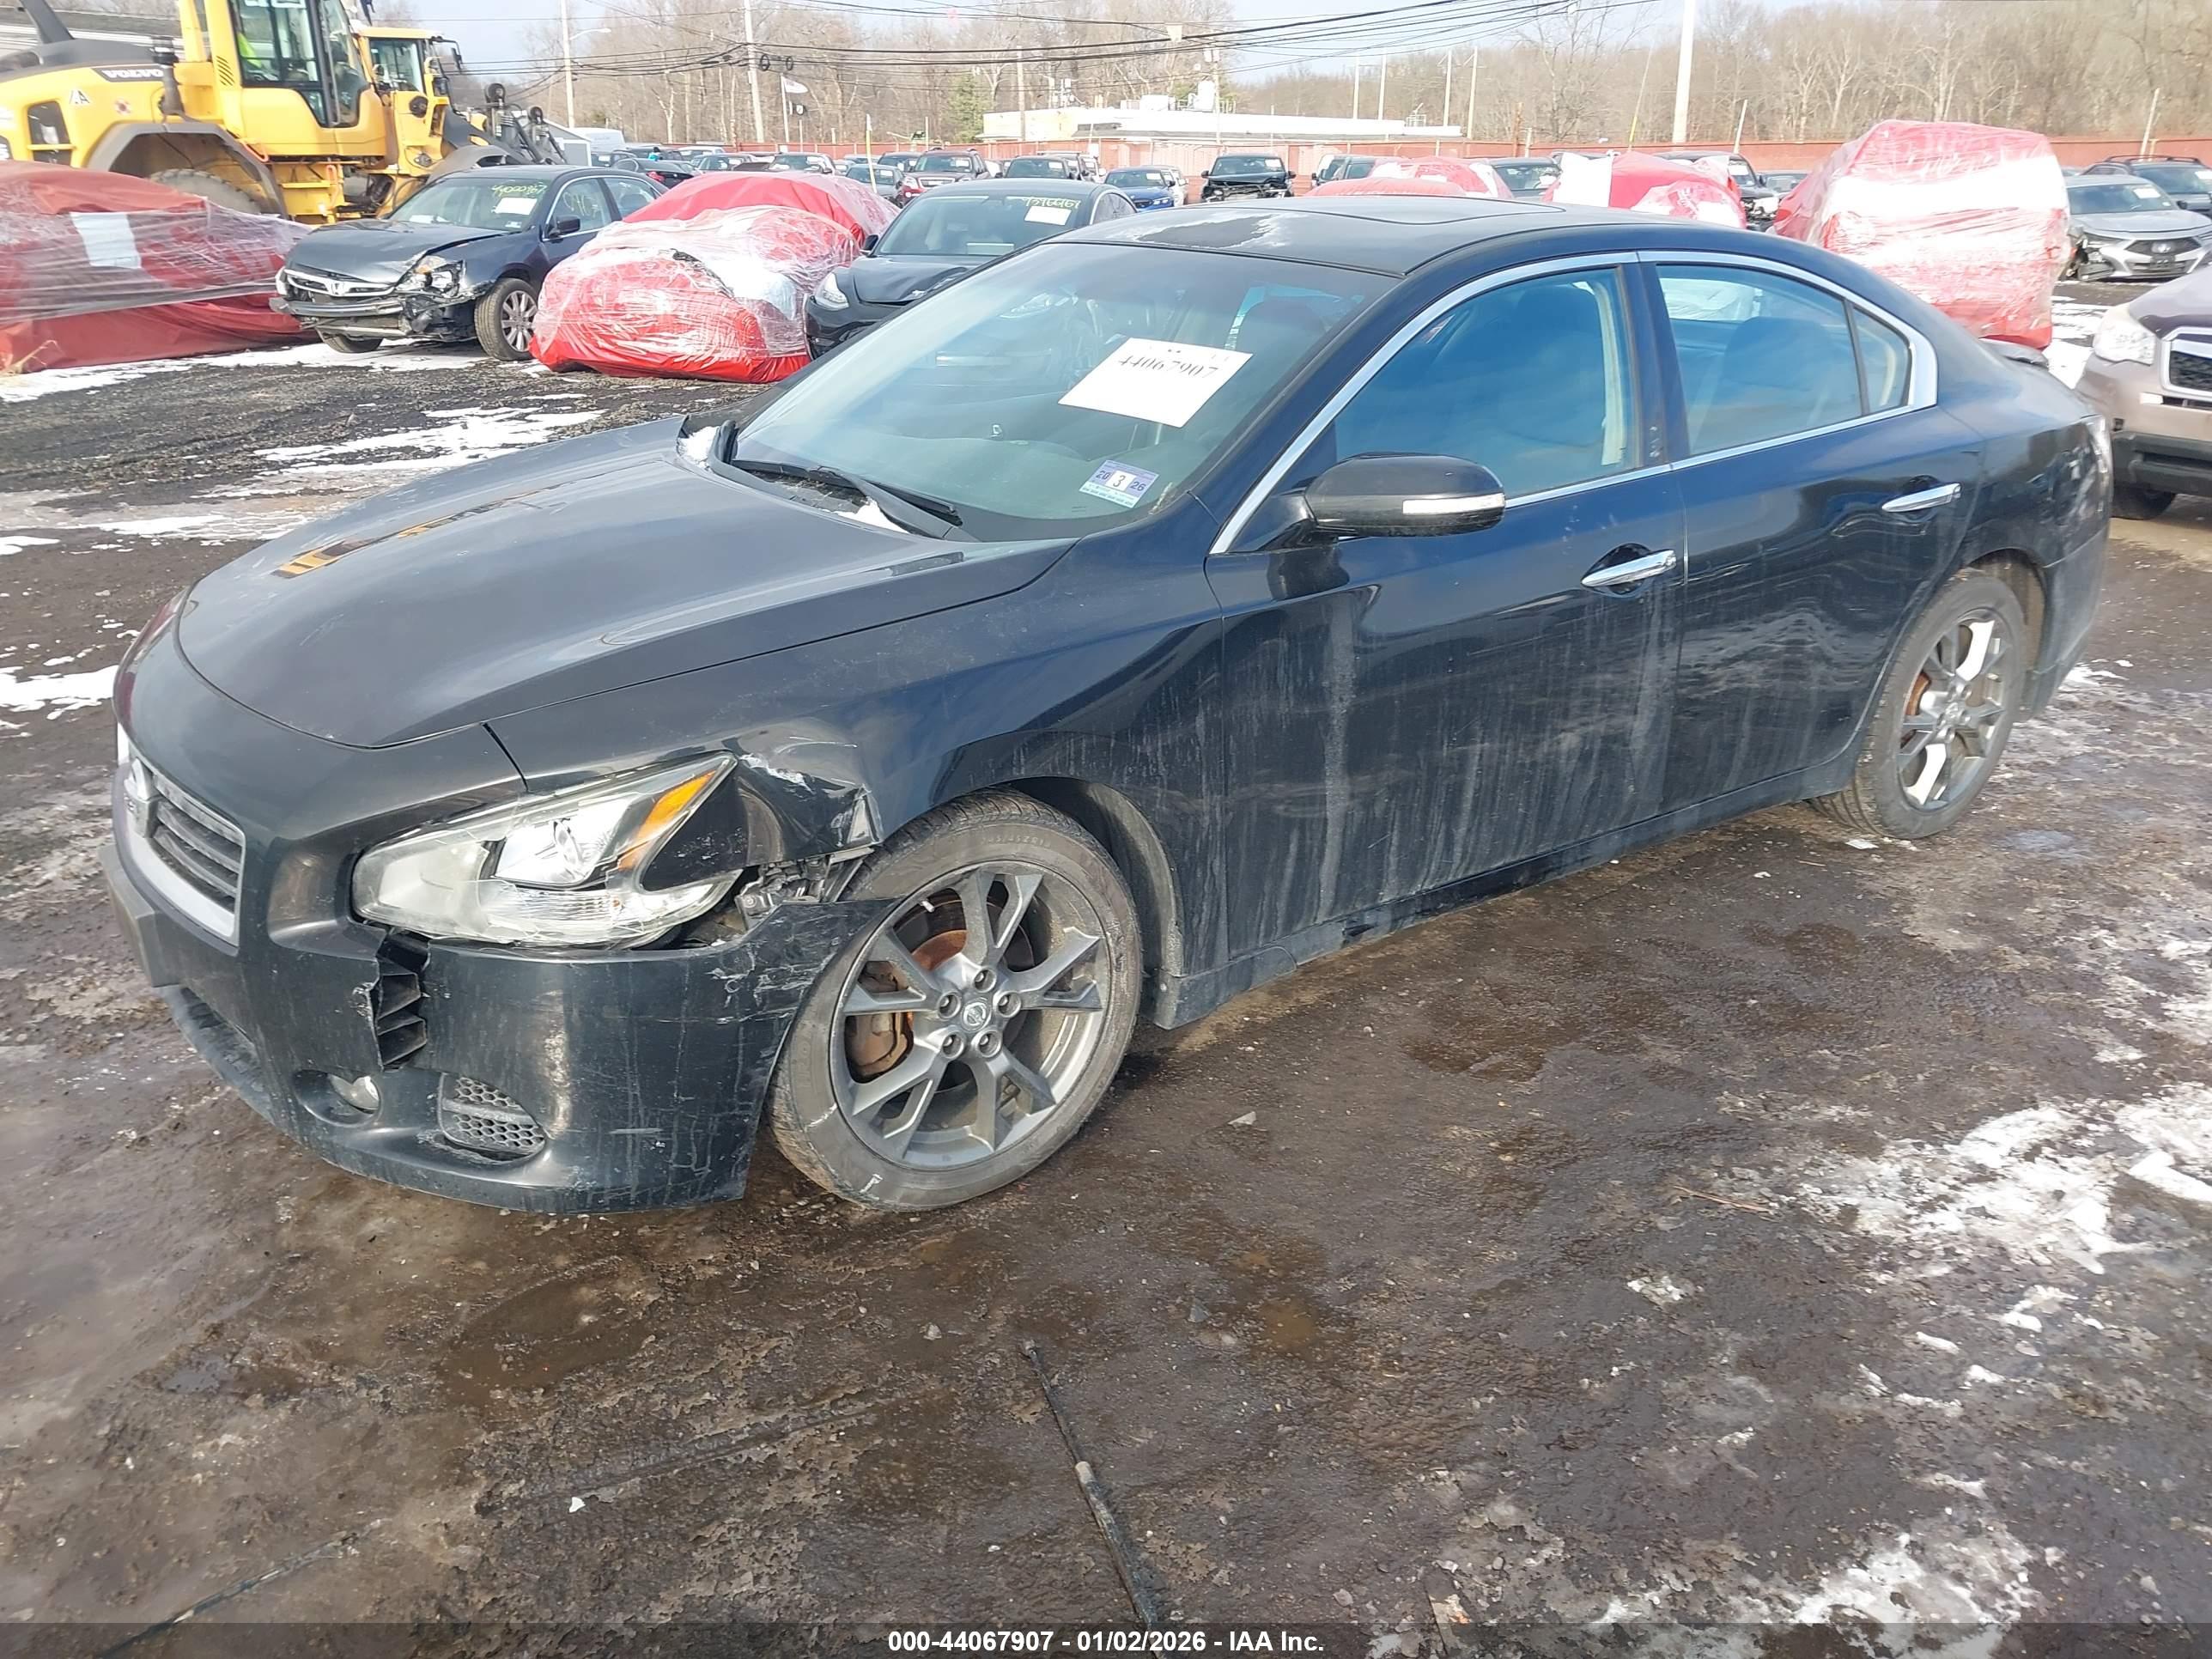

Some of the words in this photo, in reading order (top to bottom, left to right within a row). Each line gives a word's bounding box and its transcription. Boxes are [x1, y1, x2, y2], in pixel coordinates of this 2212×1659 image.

[101, 69, 165, 78] VOLVO
[1119, 354, 1219, 379] 44067907
[1096, 470, 1111, 480] 20
[1112, 475, 1126, 488] 3
[1130, 481, 1147, 491] 26
